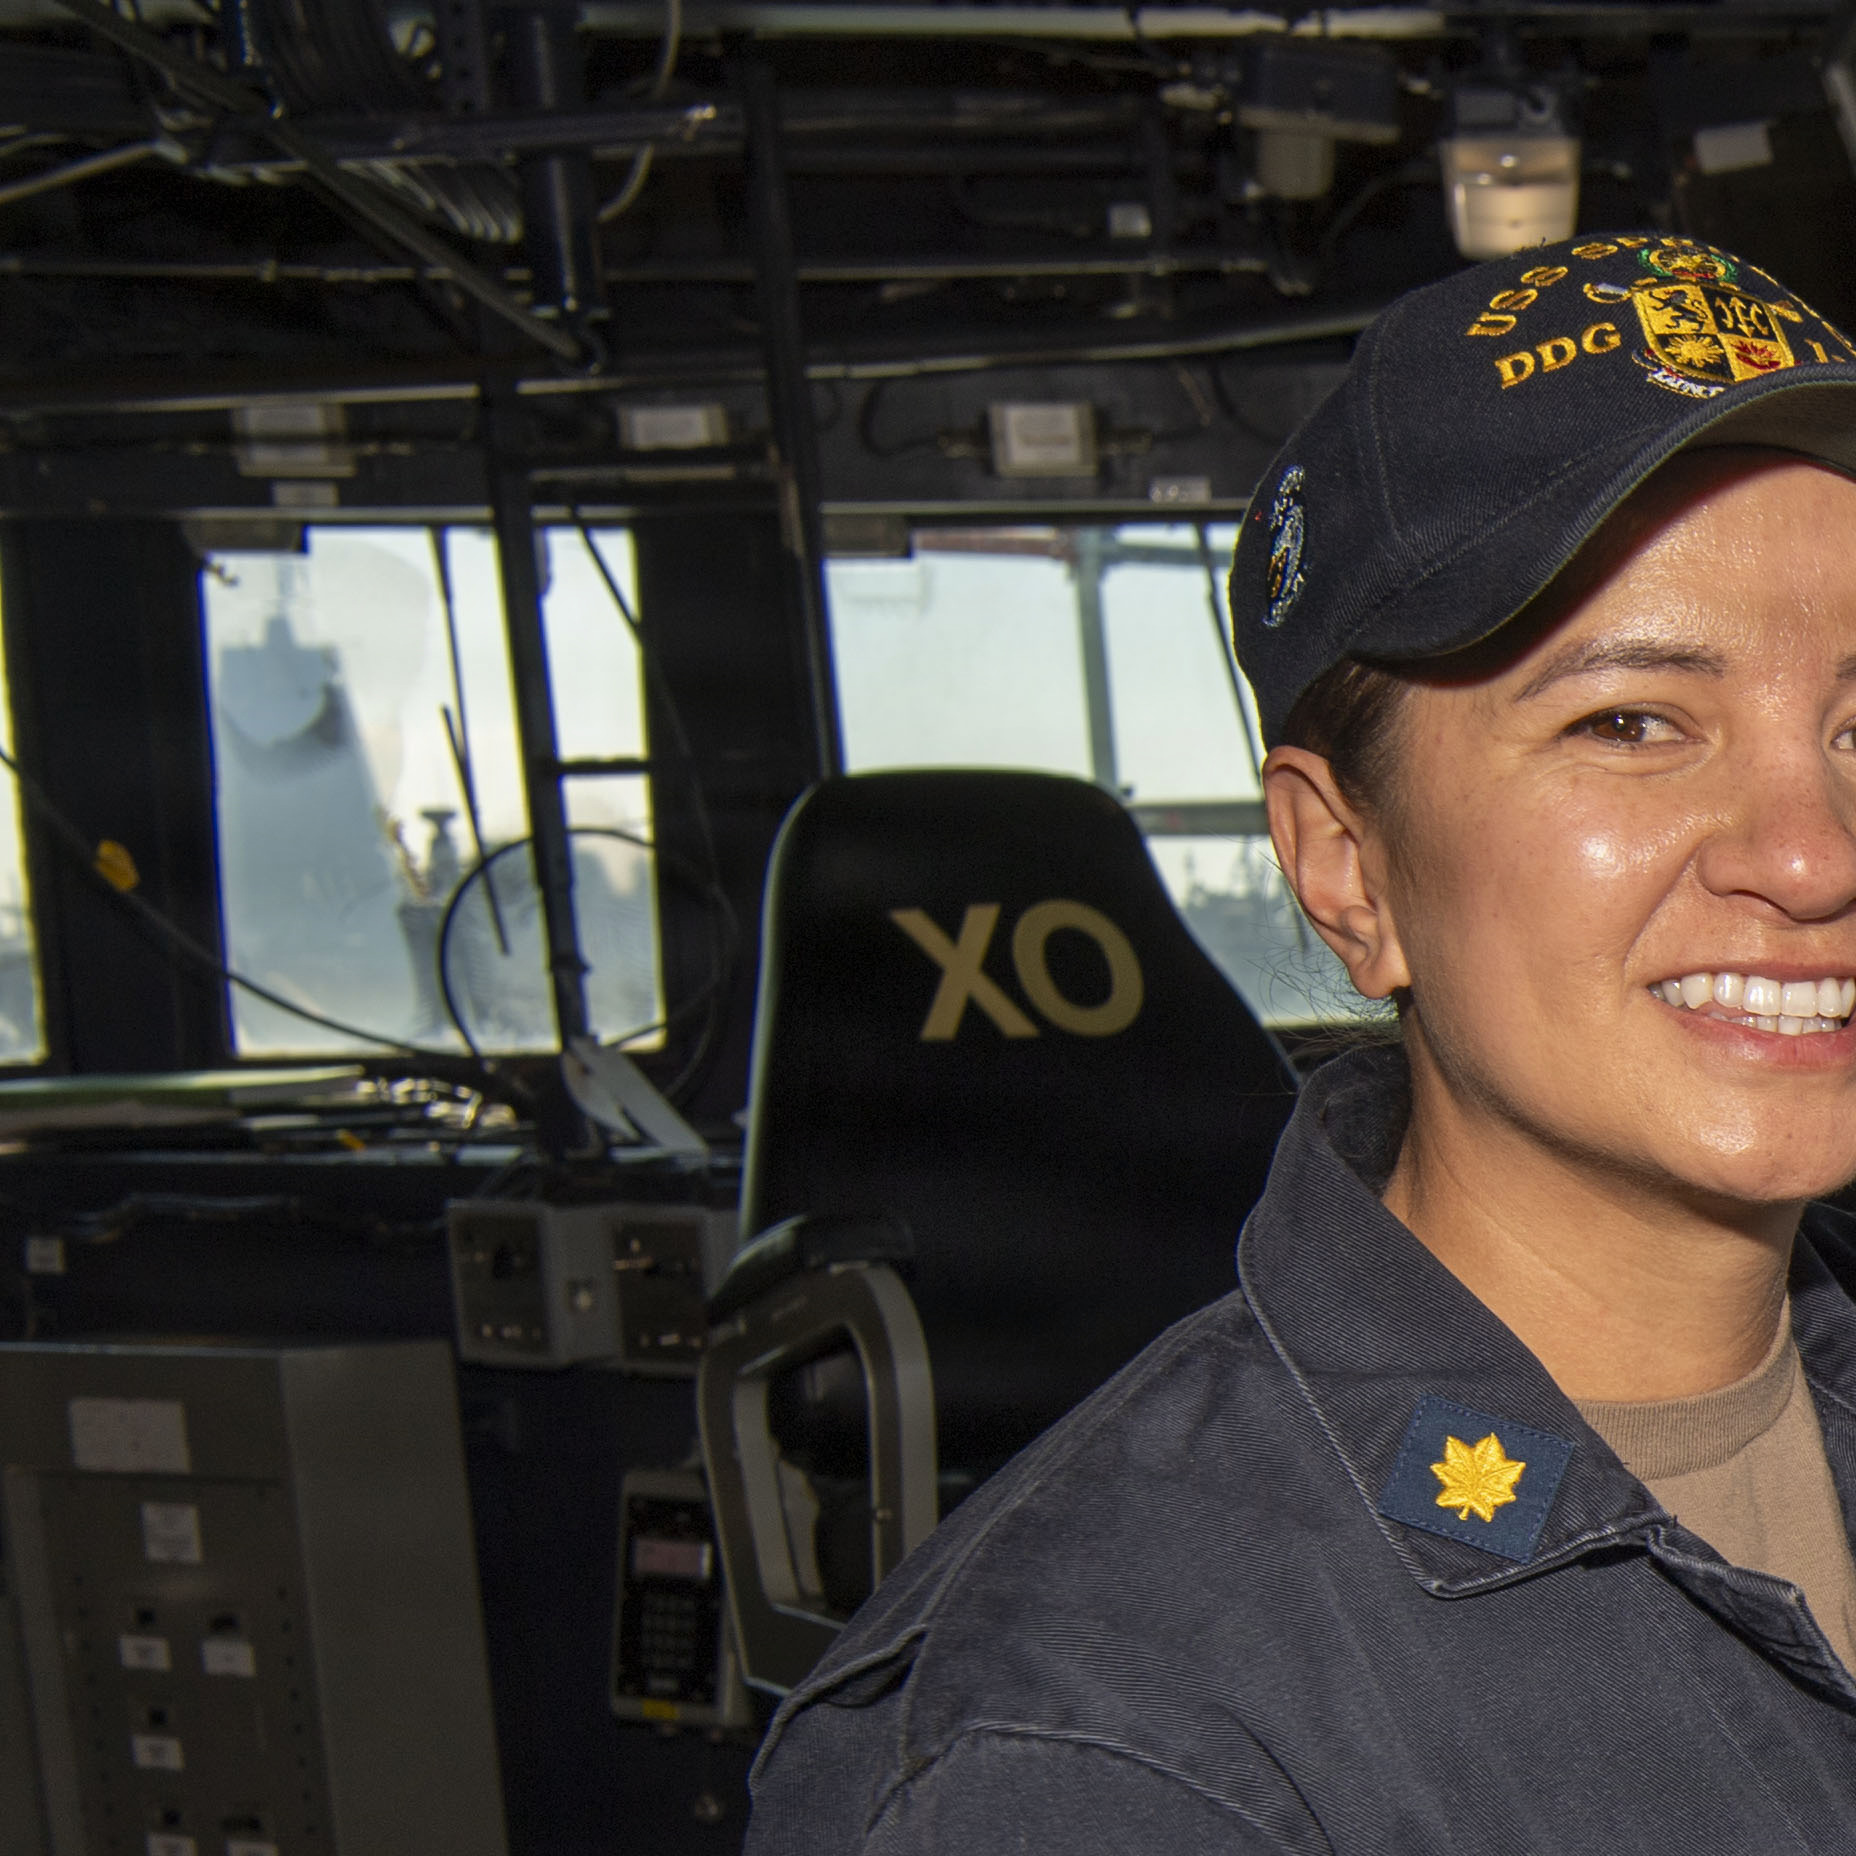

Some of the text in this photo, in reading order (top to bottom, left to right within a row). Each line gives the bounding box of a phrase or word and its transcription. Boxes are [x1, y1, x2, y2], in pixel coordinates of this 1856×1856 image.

[1465, 265, 1569, 337] USS
[1493, 321, 1623, 391] DDG
[887, 897, 1145, 1042] XO
